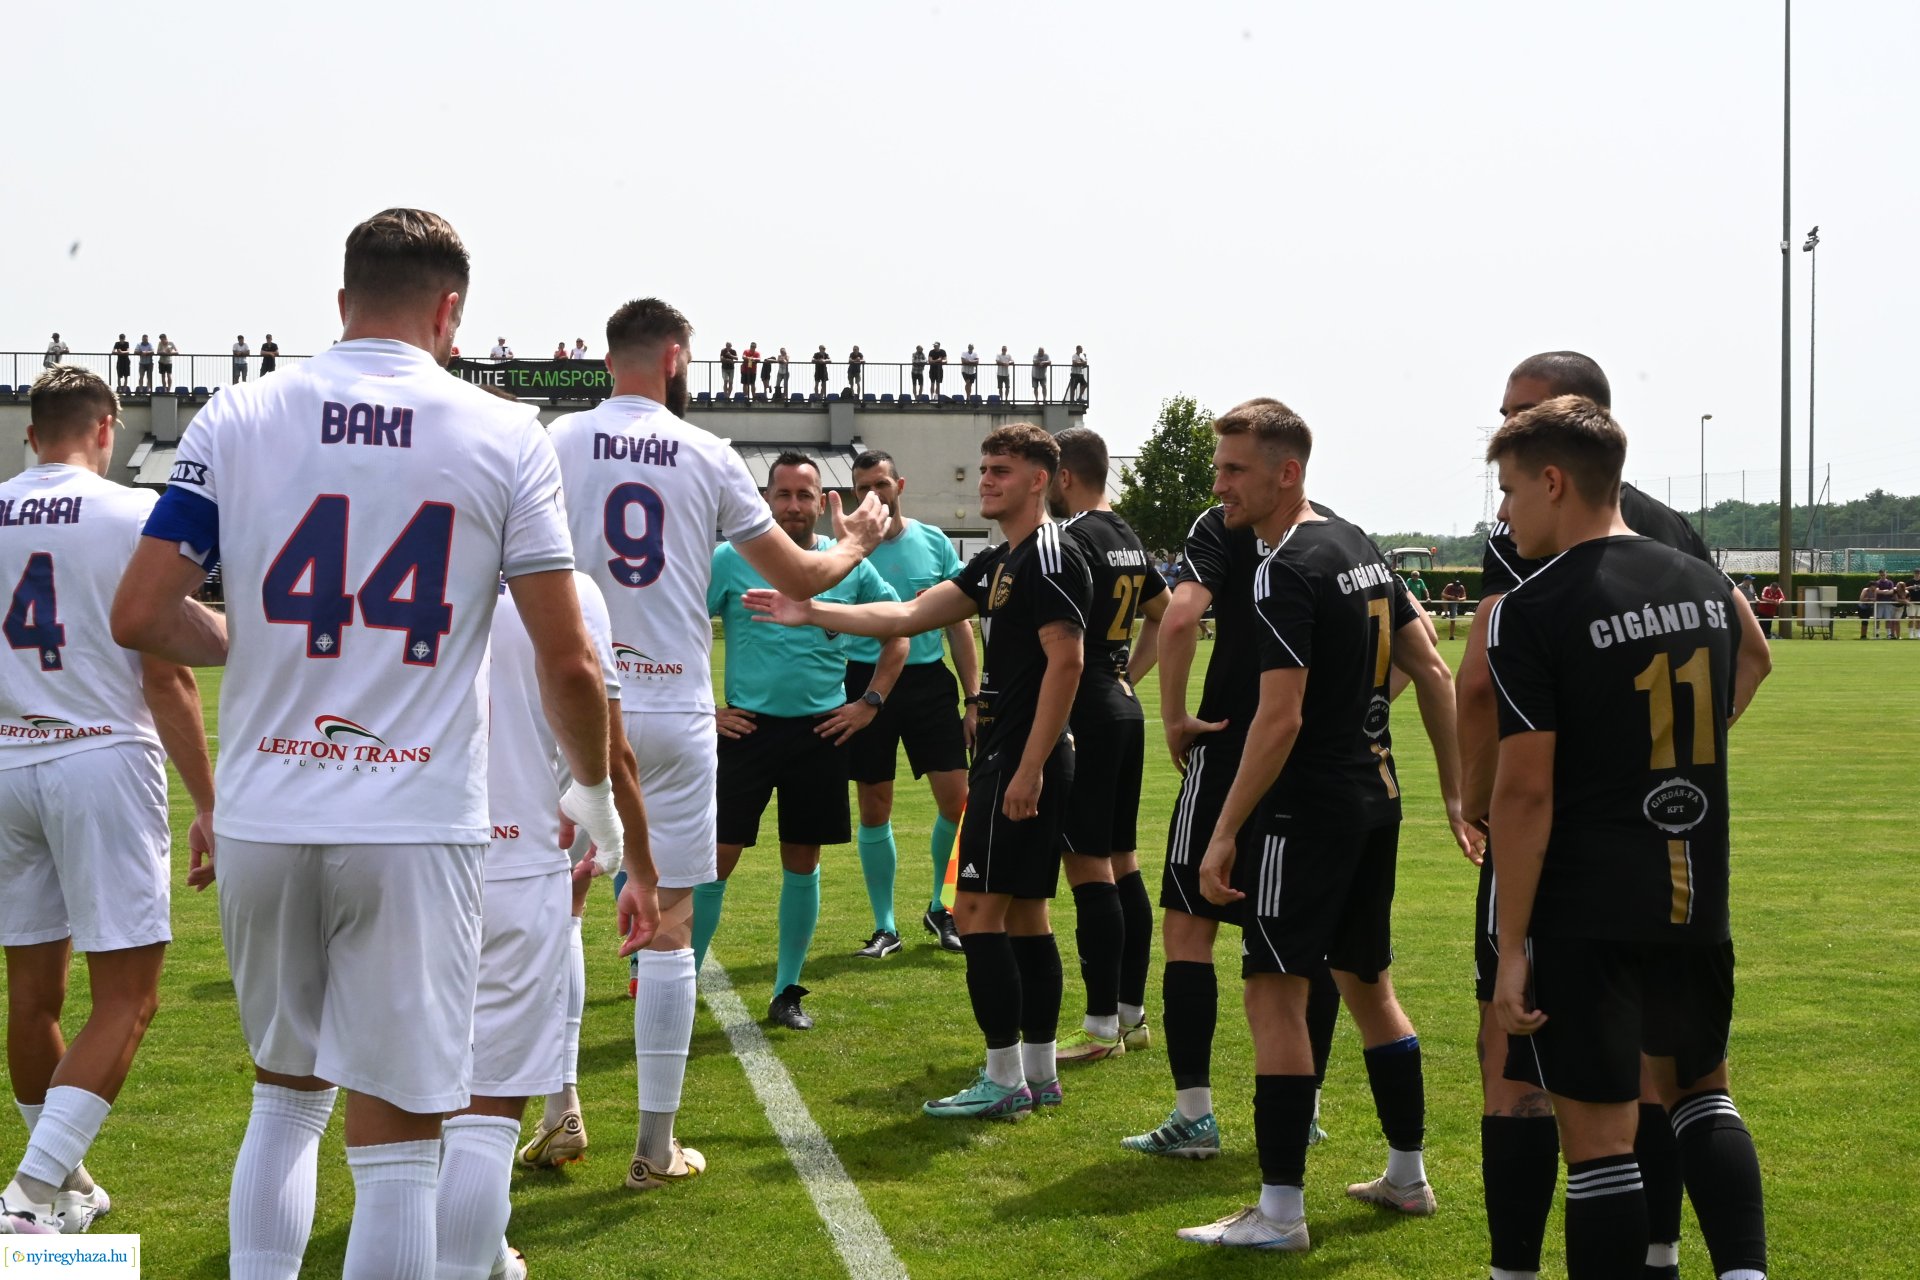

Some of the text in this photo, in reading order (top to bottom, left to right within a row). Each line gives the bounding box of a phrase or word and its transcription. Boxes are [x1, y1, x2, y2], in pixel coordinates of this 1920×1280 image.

[321, 401, 414, 448] BAKI
[593, 433, 679, 467] NOVÁK
[604, 482, 665, 588] 9
[262, 494, 455, 667] 44
[3, 552, 65, 671] 4
[1106, 574, 1146, 640] 27
[1588, 600, 1728, 649] CIGÁND SE
[1368, 598, 1390, 688] 7
[634, 662, 683, 675] TRANS
[53, 725, 113, 739] TRANS
[1633, 646, 1716, 770] 11
[257, 736, 432, 763] LERTON TRANS
[283, 758, 397, 773] HUNGARY
